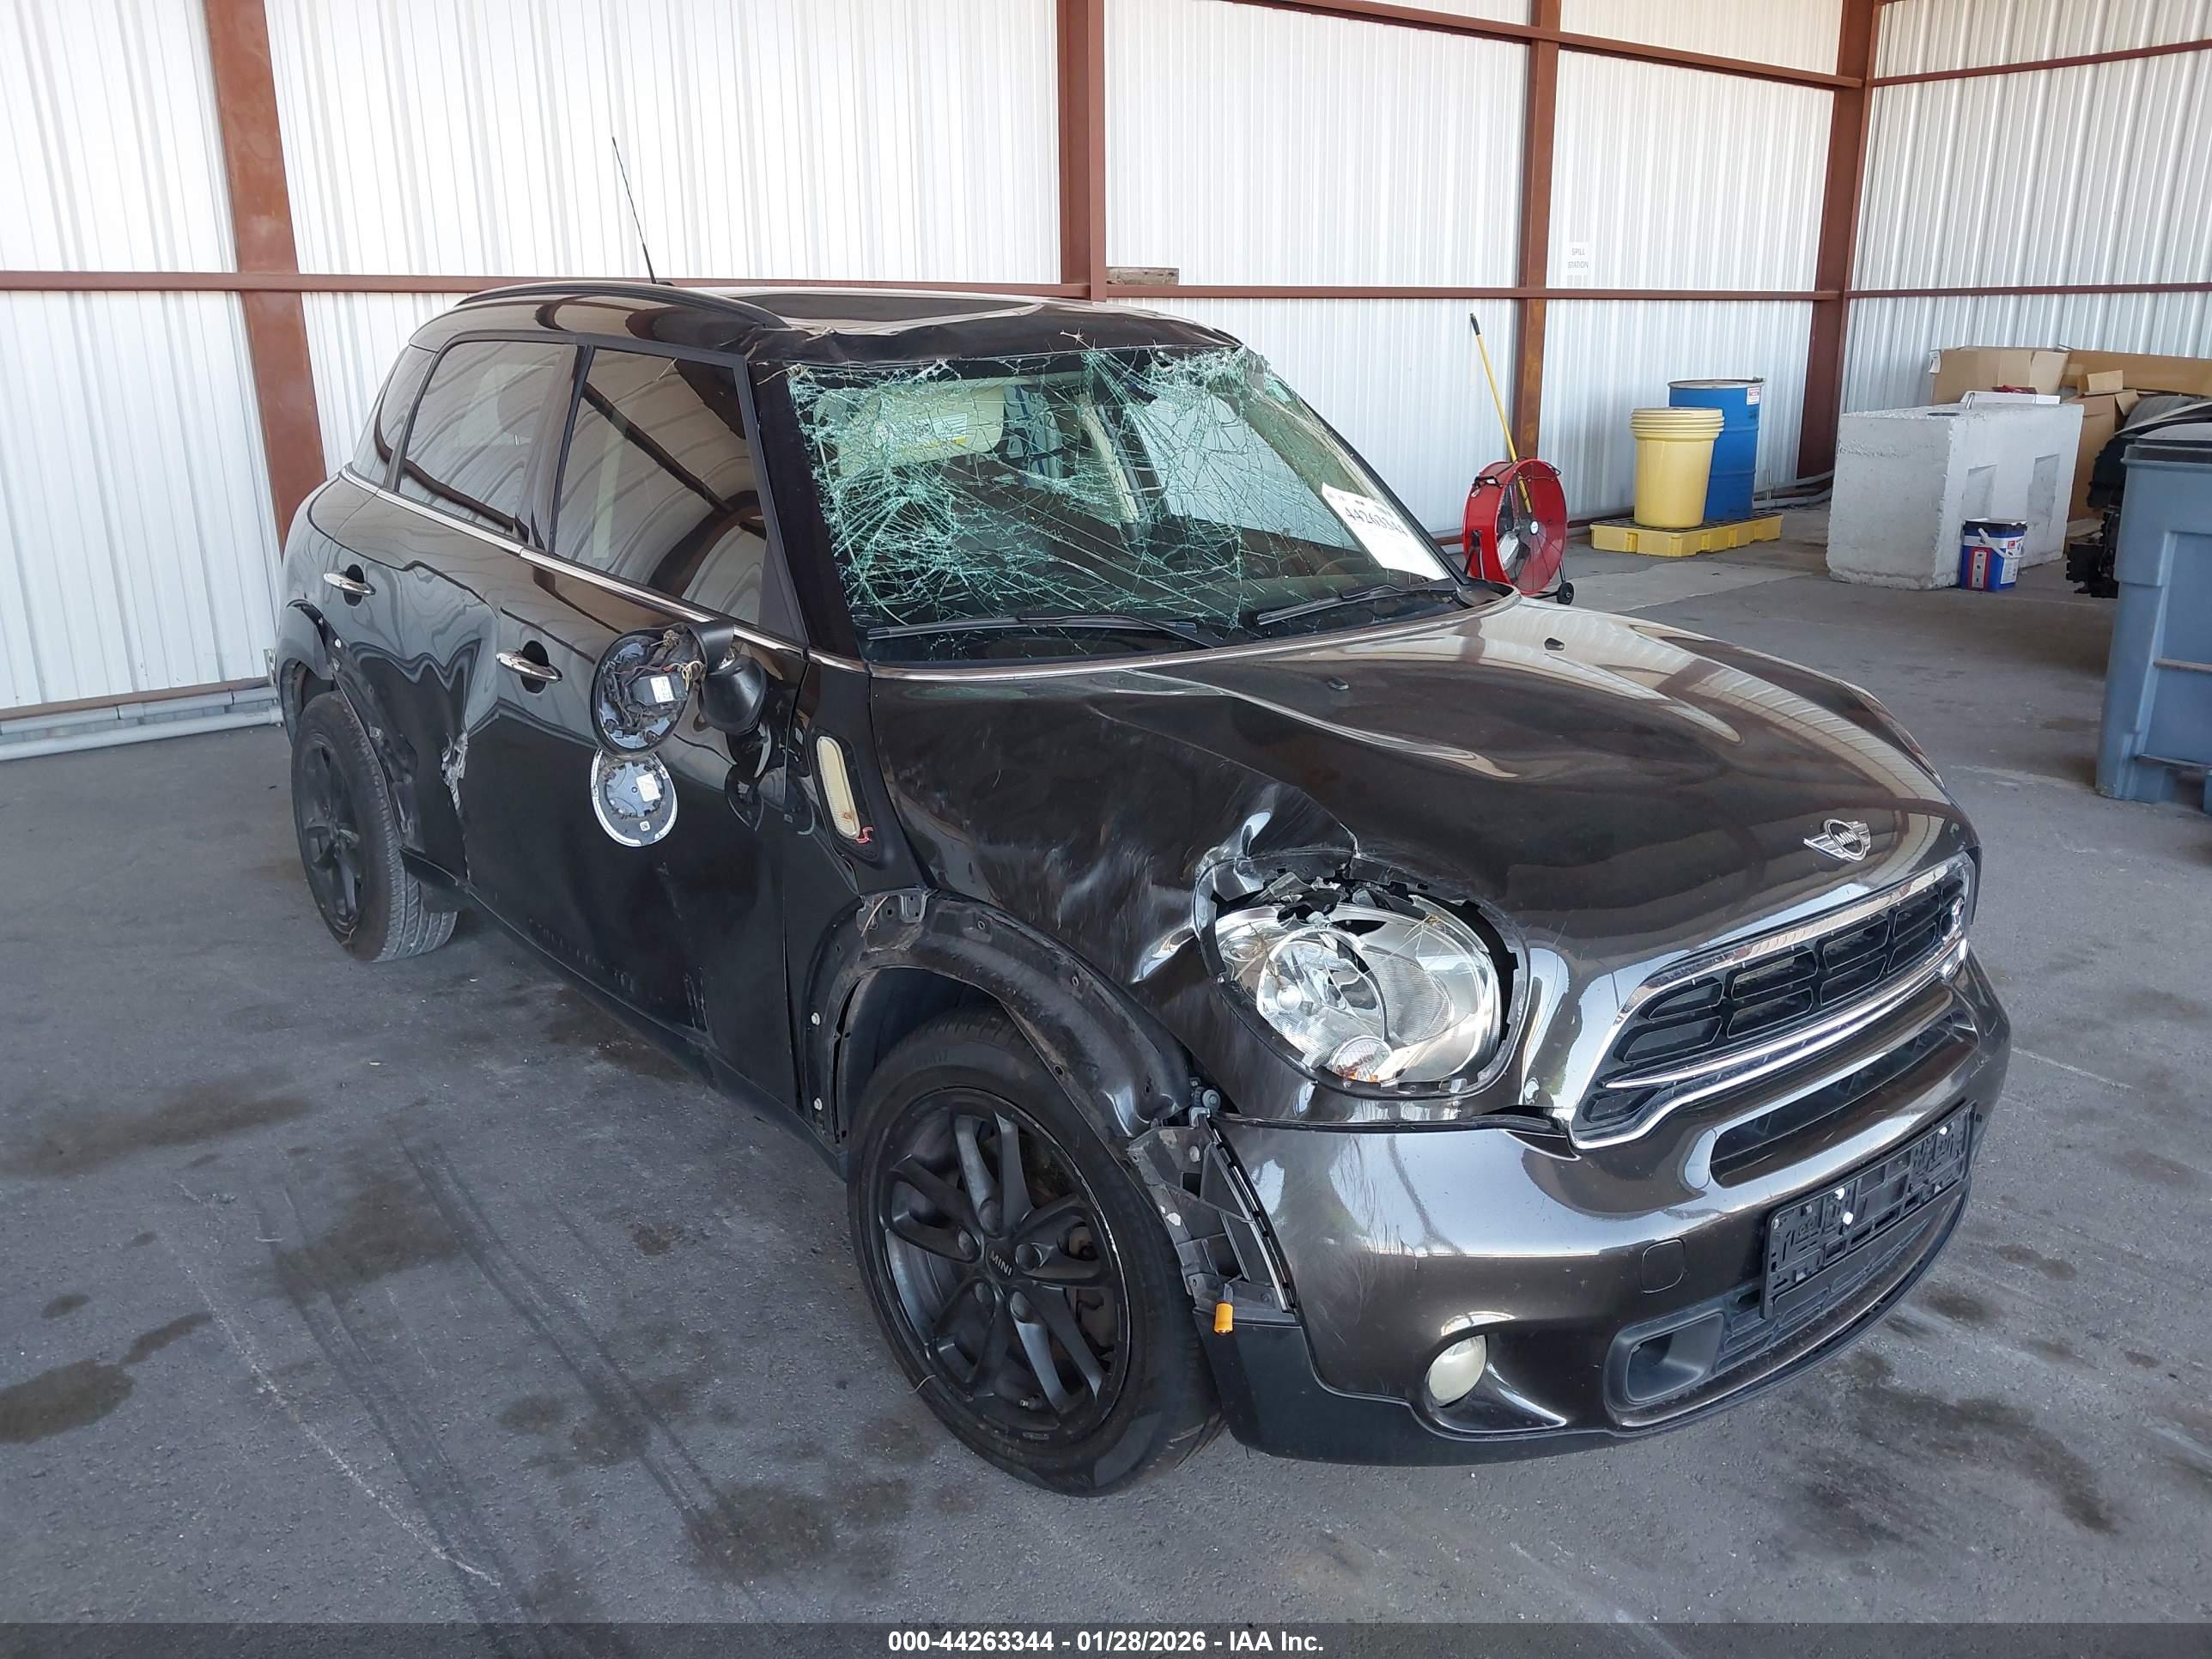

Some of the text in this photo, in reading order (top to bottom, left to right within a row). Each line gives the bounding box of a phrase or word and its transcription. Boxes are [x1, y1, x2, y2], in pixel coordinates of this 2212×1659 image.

[1568, 260, 1589, 269] STATION
[1833, 830, 1860, 846] MINI
[990, 1250, 1012, 1276] MINI
